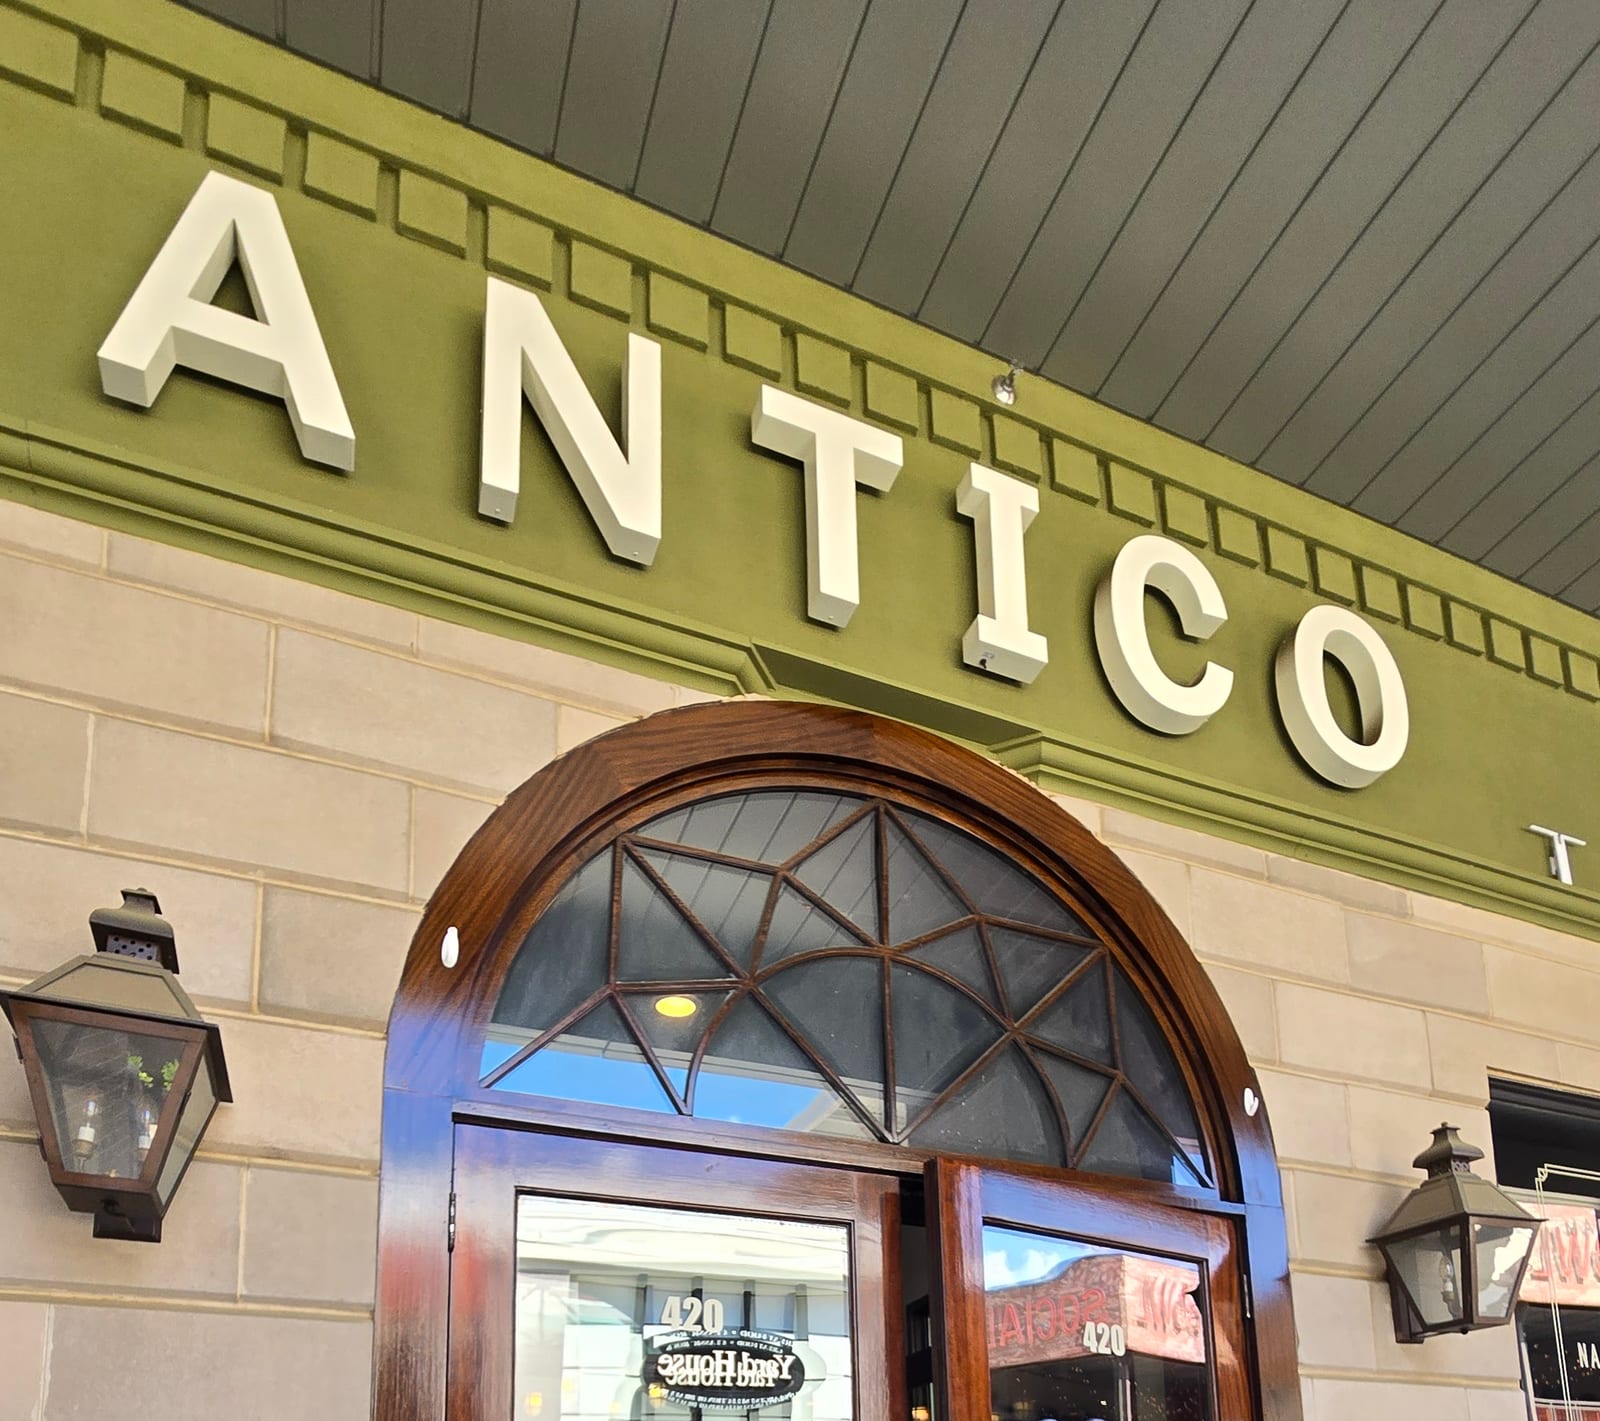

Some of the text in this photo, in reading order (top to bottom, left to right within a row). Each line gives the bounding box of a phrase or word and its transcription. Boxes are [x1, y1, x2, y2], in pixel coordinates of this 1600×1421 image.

[97, 169, 1410, 790] ANTICO
[661, 1295, 724, 1334] 420
[1083, 1321, 1126, 1357] 420
